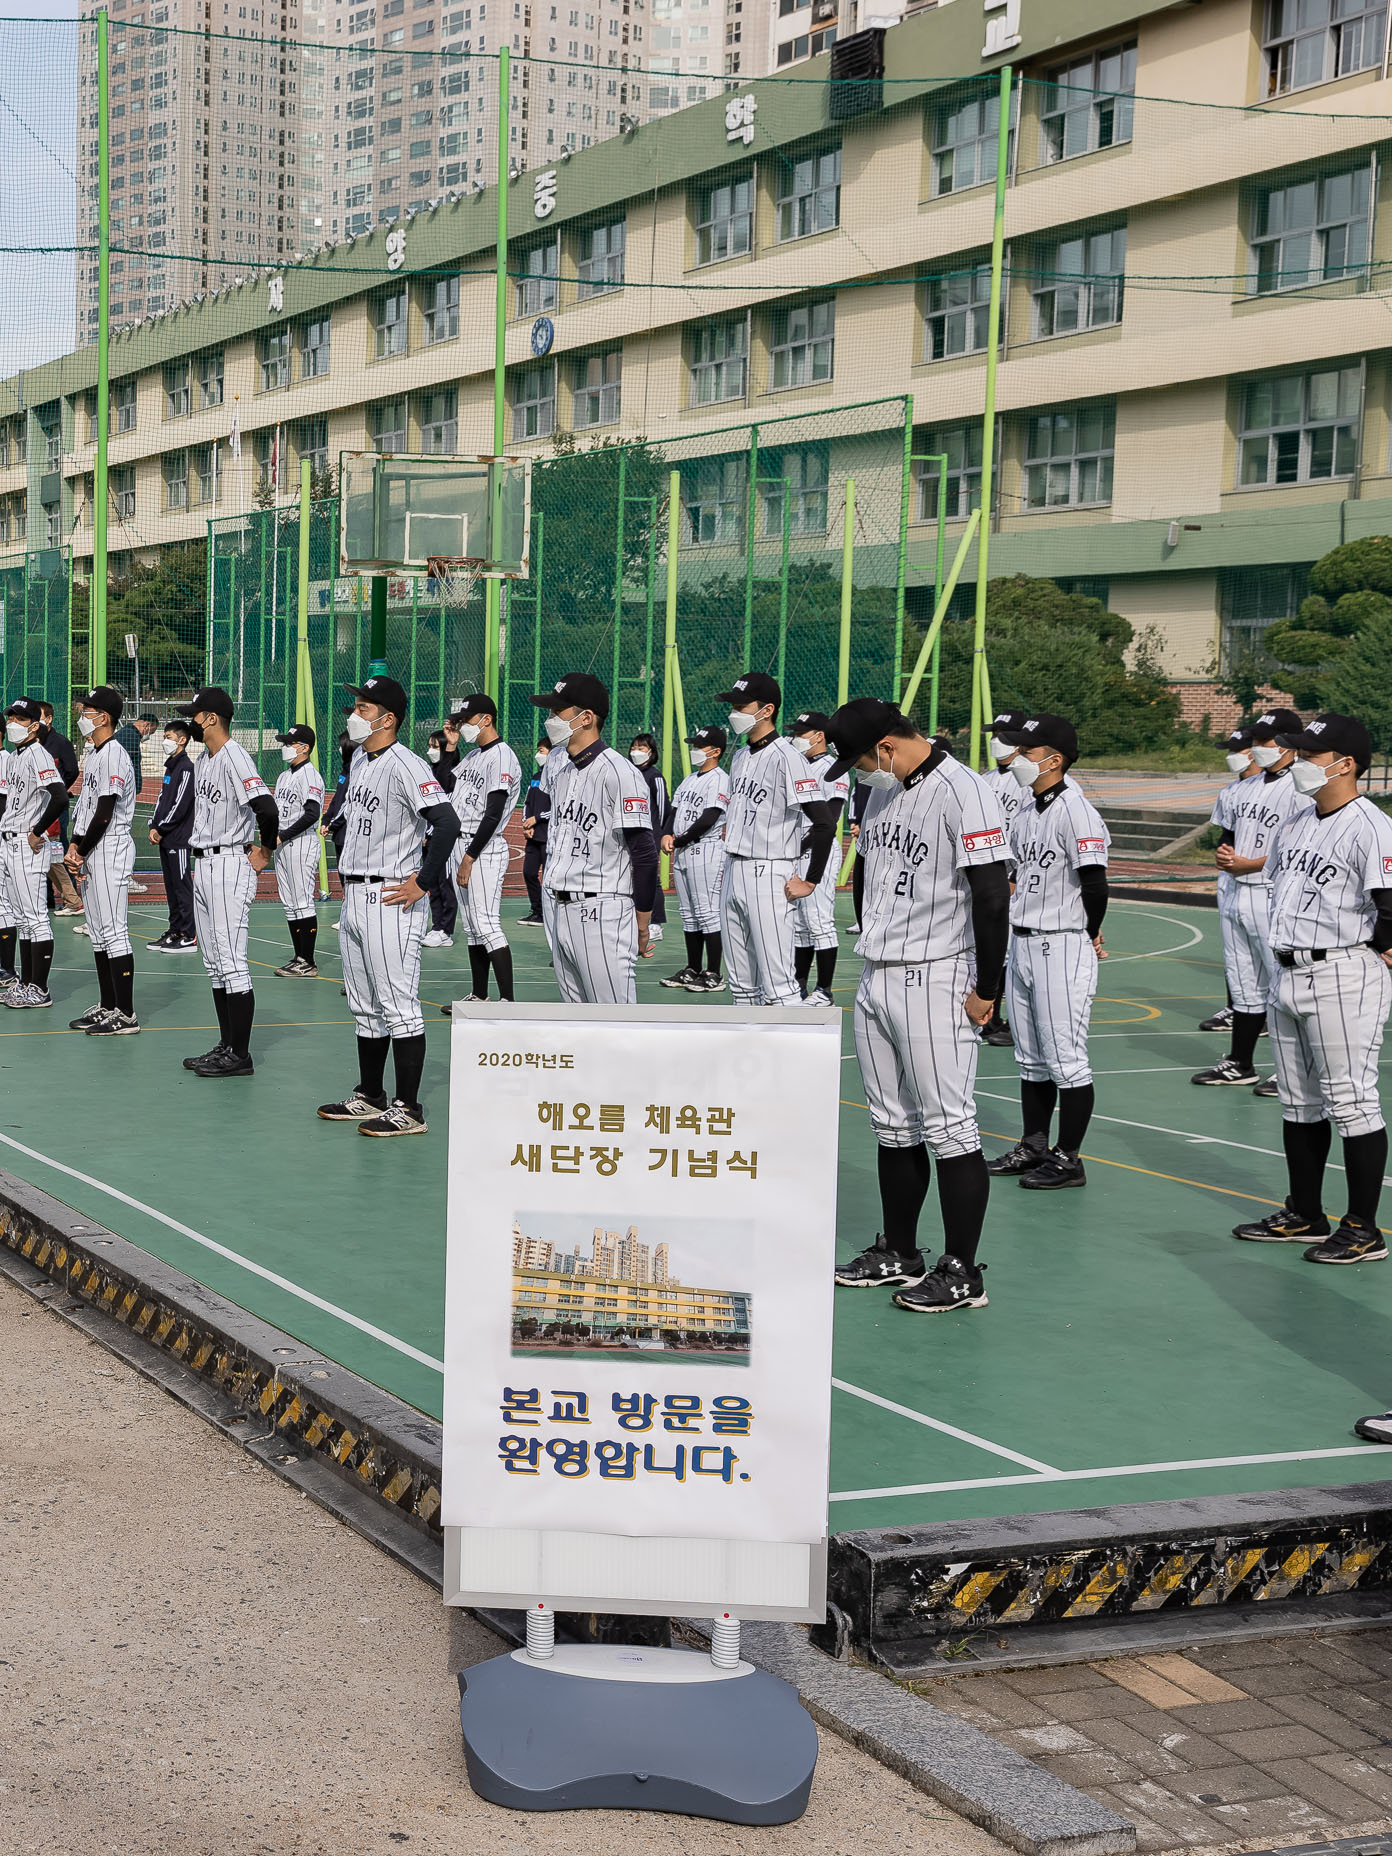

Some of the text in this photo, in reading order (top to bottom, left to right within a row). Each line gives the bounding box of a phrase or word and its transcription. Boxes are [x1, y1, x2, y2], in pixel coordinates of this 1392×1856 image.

[282, 806, 289, 818] 5
[744, 809, 757, 826] 17
[358, 818, 372, 836] 18
[571, 837, 590, 858] 24
[865, 822, 928, 868] JAYANG
[984, 834, 1003, 846] 자양
[1254, 833, 1265, 849] 6
[894, 870, 915, 899] 21
[1028, 874, 1040, 894] 2
[365, 891, 377, 905] 18
[1303, 891, 1317, 912] 7
[580, 908, 598, 923] 24
[905, 969, 922, 988] 21
[1305, 974, 1314, 990] 7
[478, 1052, 575, 1069] 2020학년도
[537, 1101, 736, 1136] 해오름 체육관
[510, 1143, 758, 1180] 새단장 기념식
[499, 1386, 755, 1437] 본교 방문을
[497, 1434, 752, 1485] 환영합니다.
